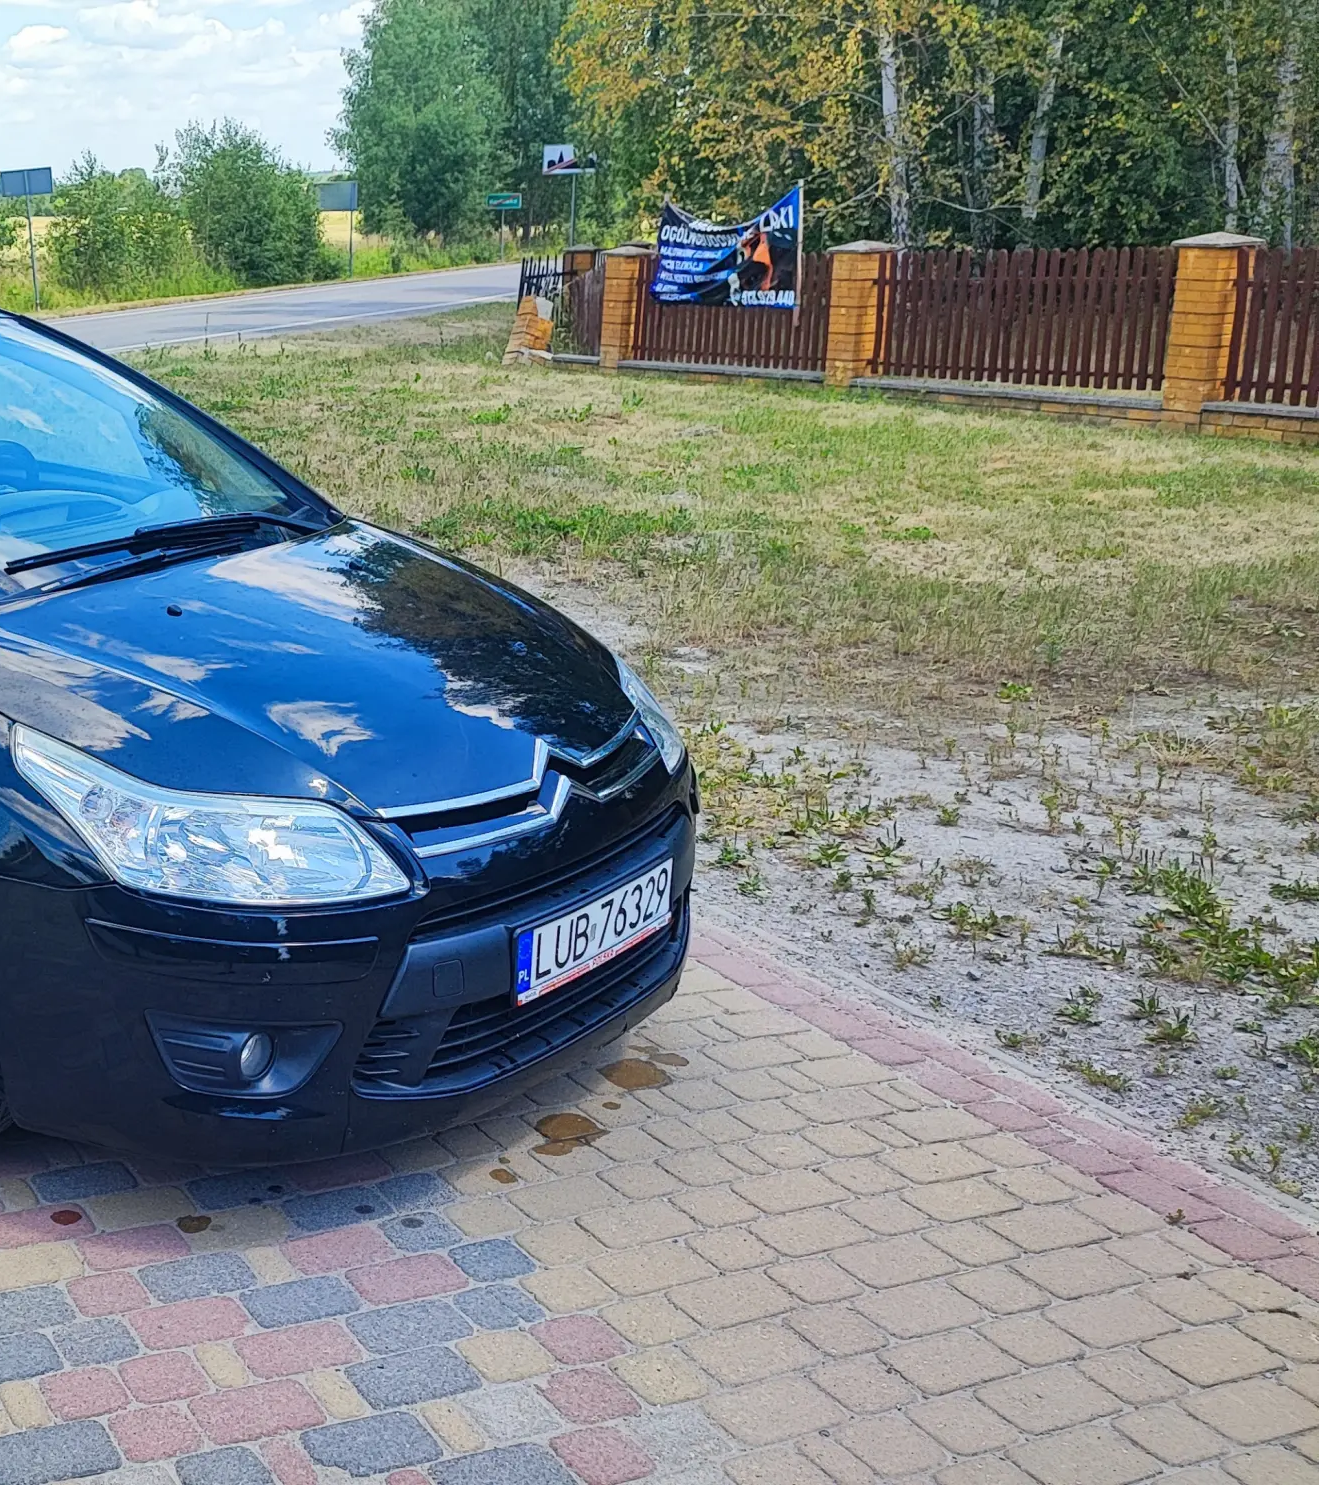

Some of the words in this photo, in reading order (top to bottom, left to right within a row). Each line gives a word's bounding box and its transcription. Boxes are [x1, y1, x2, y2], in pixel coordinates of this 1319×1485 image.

[535, 912, 590, 981] LUB
[598, 867, 669, 949] 76329
[518, 970, 530, 984] PL
